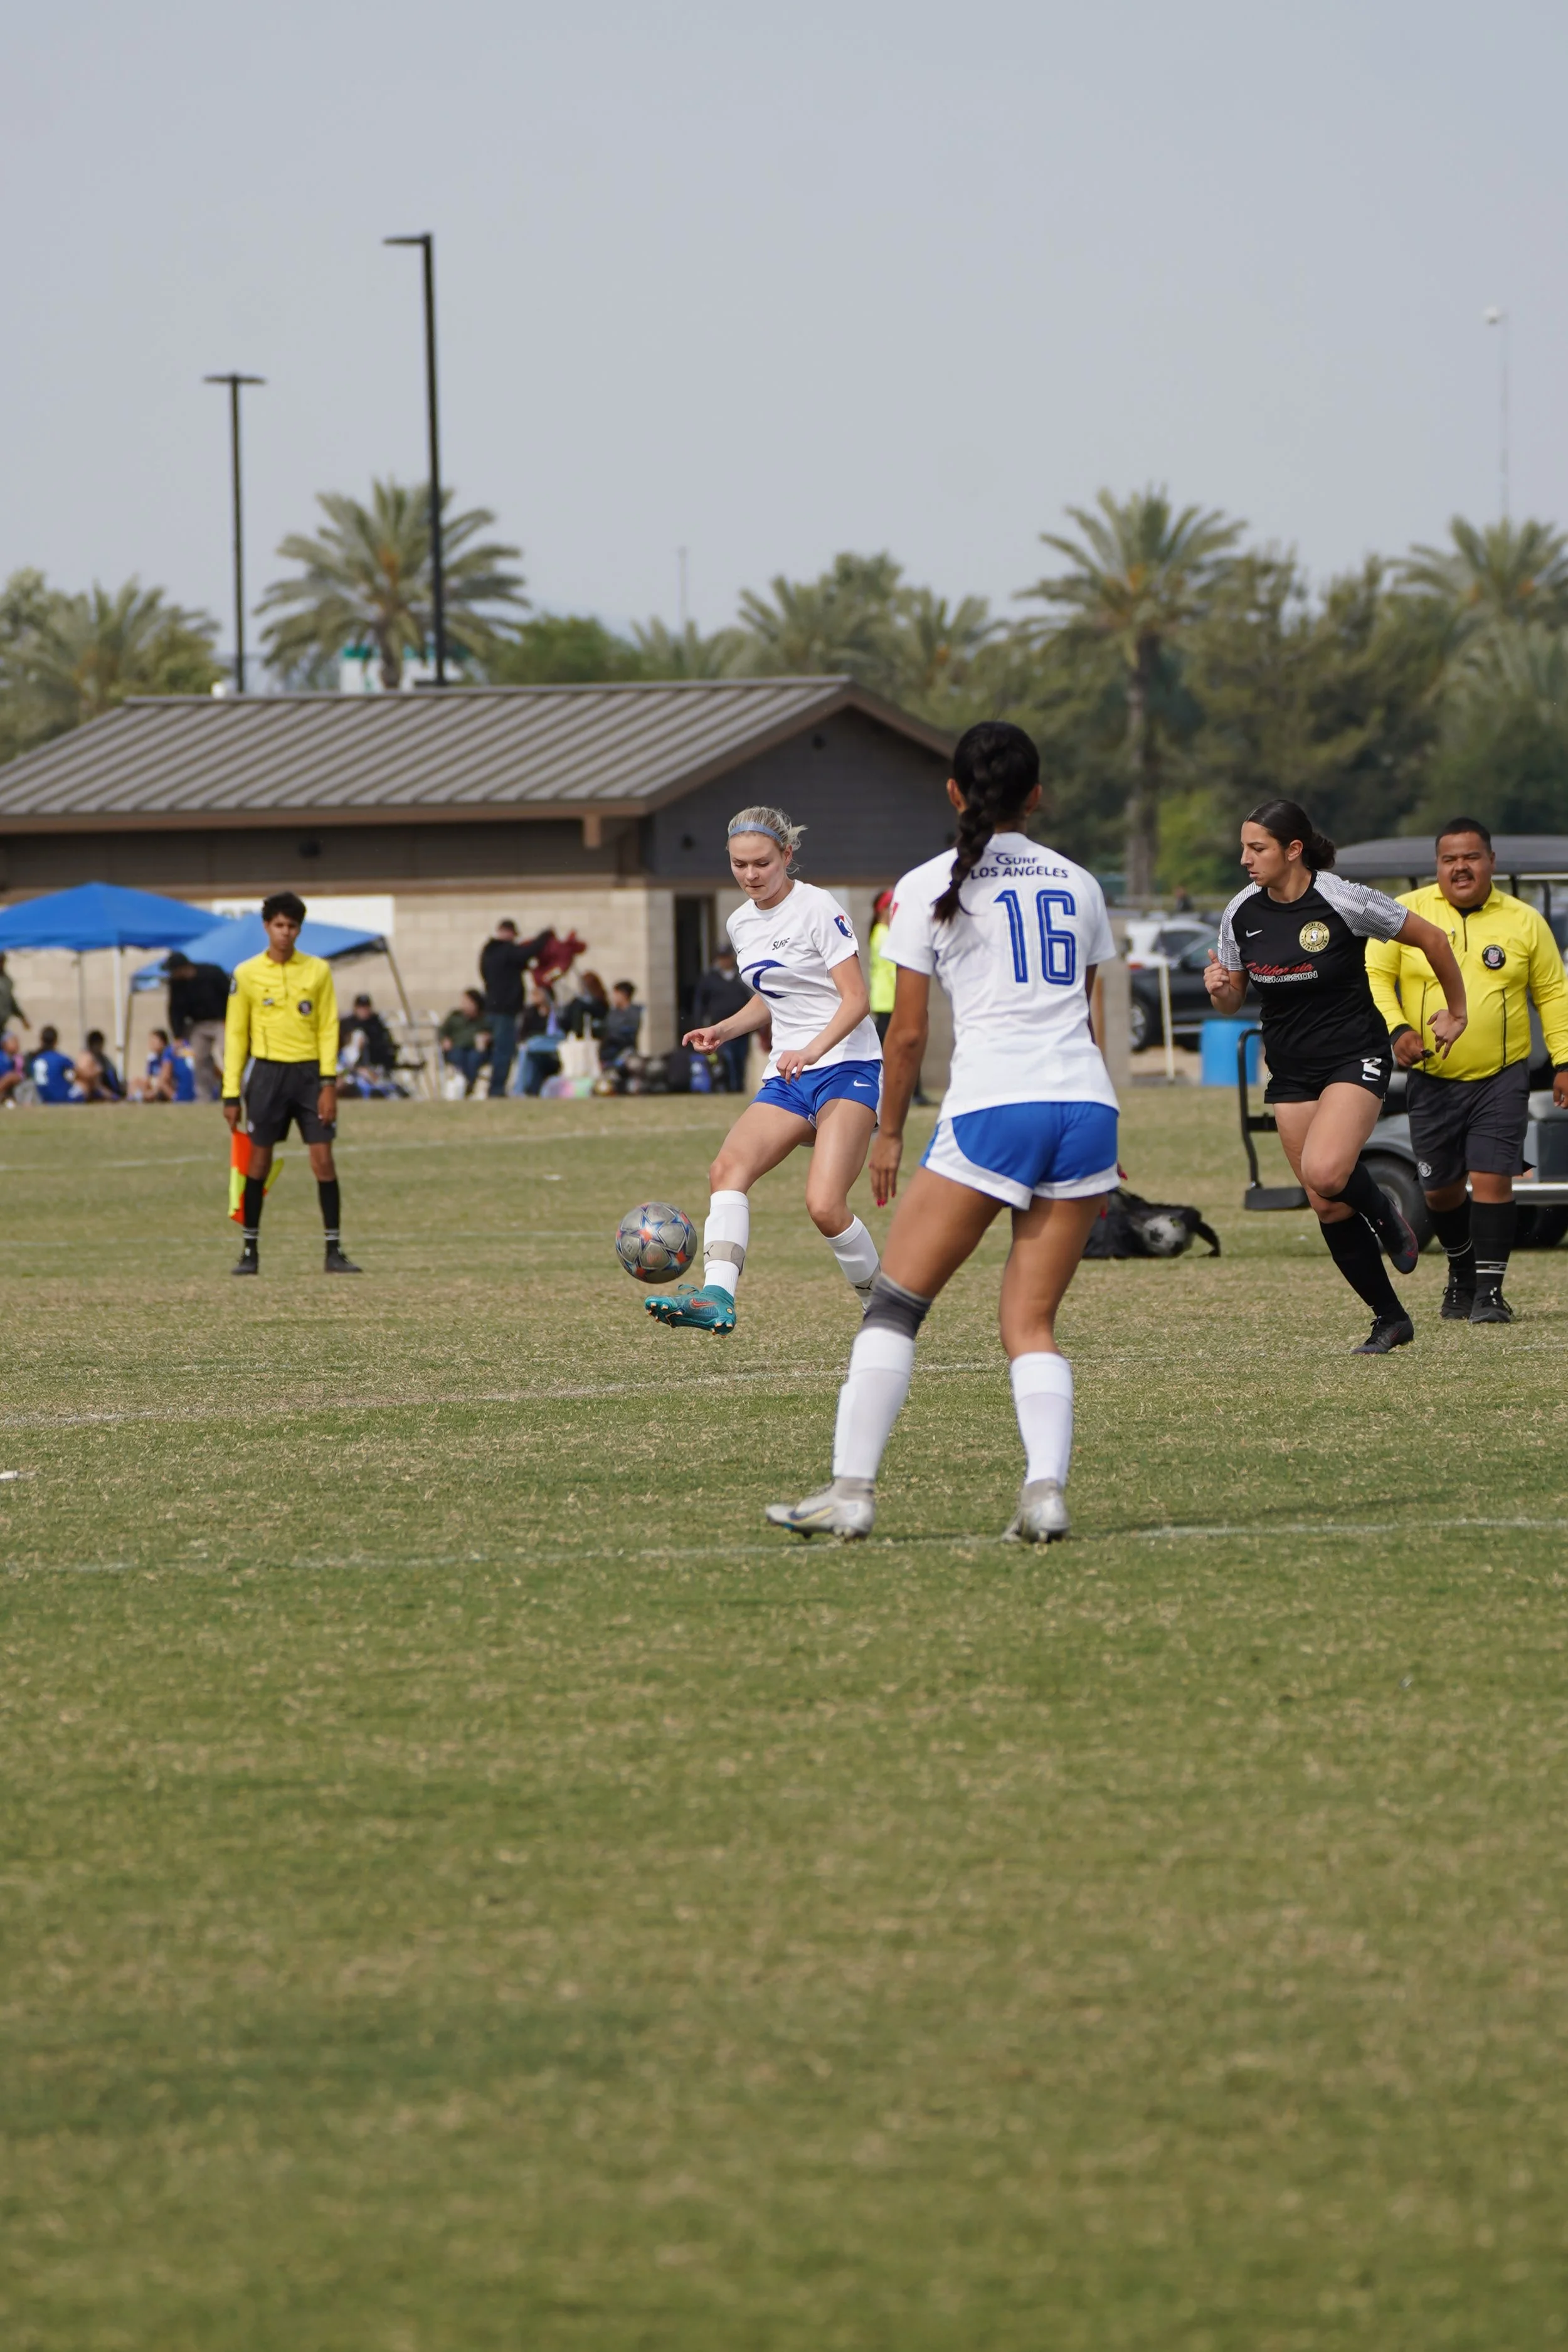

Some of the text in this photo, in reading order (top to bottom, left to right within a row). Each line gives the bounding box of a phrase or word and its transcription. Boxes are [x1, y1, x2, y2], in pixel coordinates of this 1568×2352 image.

[971, 866, 1069, 879] LOS ANGELES
[993, 889, 1077, 986] 16
[1360, 1057, 1382, 1076] 2
